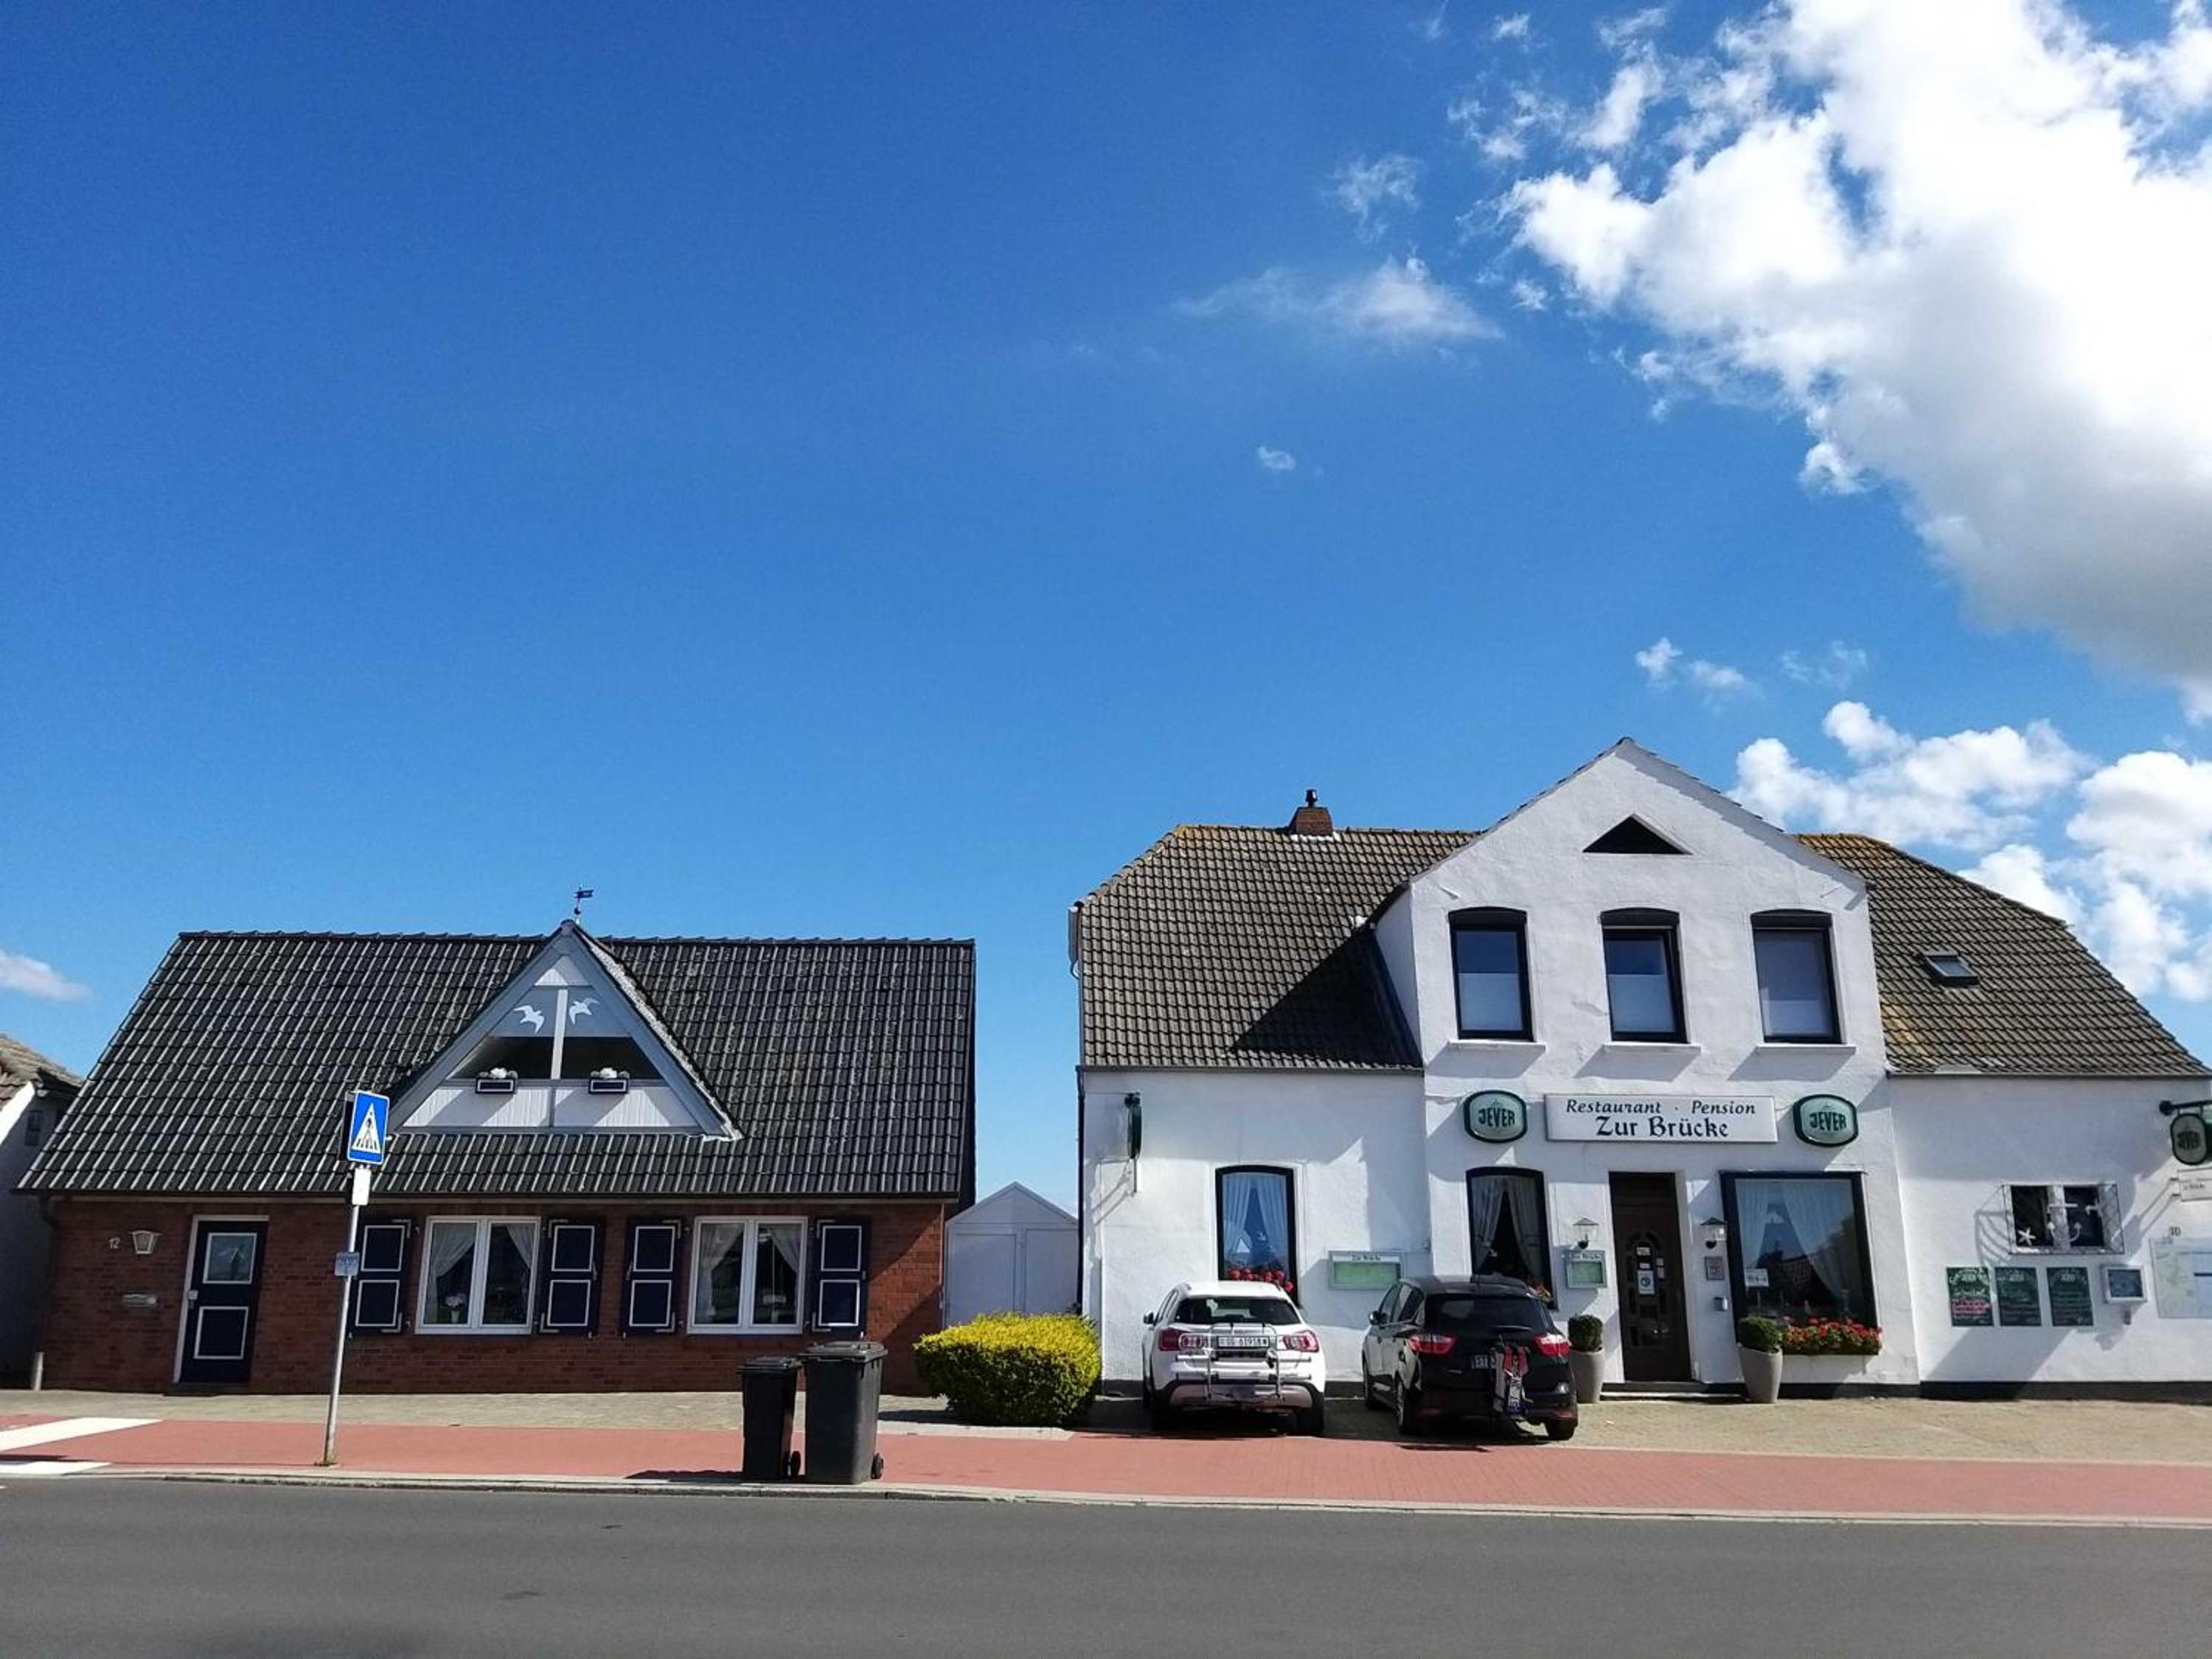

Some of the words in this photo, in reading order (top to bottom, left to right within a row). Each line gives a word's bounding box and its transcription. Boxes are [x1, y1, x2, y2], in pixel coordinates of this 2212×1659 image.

[1478, 1107, 1515, 1127] JEVER
[1566, 1099, 1661, 1114] Restaurant
[1691, 1100, 1756, 1115] Pension
[1595, 1116, 1638, 1136] Zur
[1648, 1116, 1729, 1138] Brücke
[1809, 1111, 1847, 1132] JEVER
